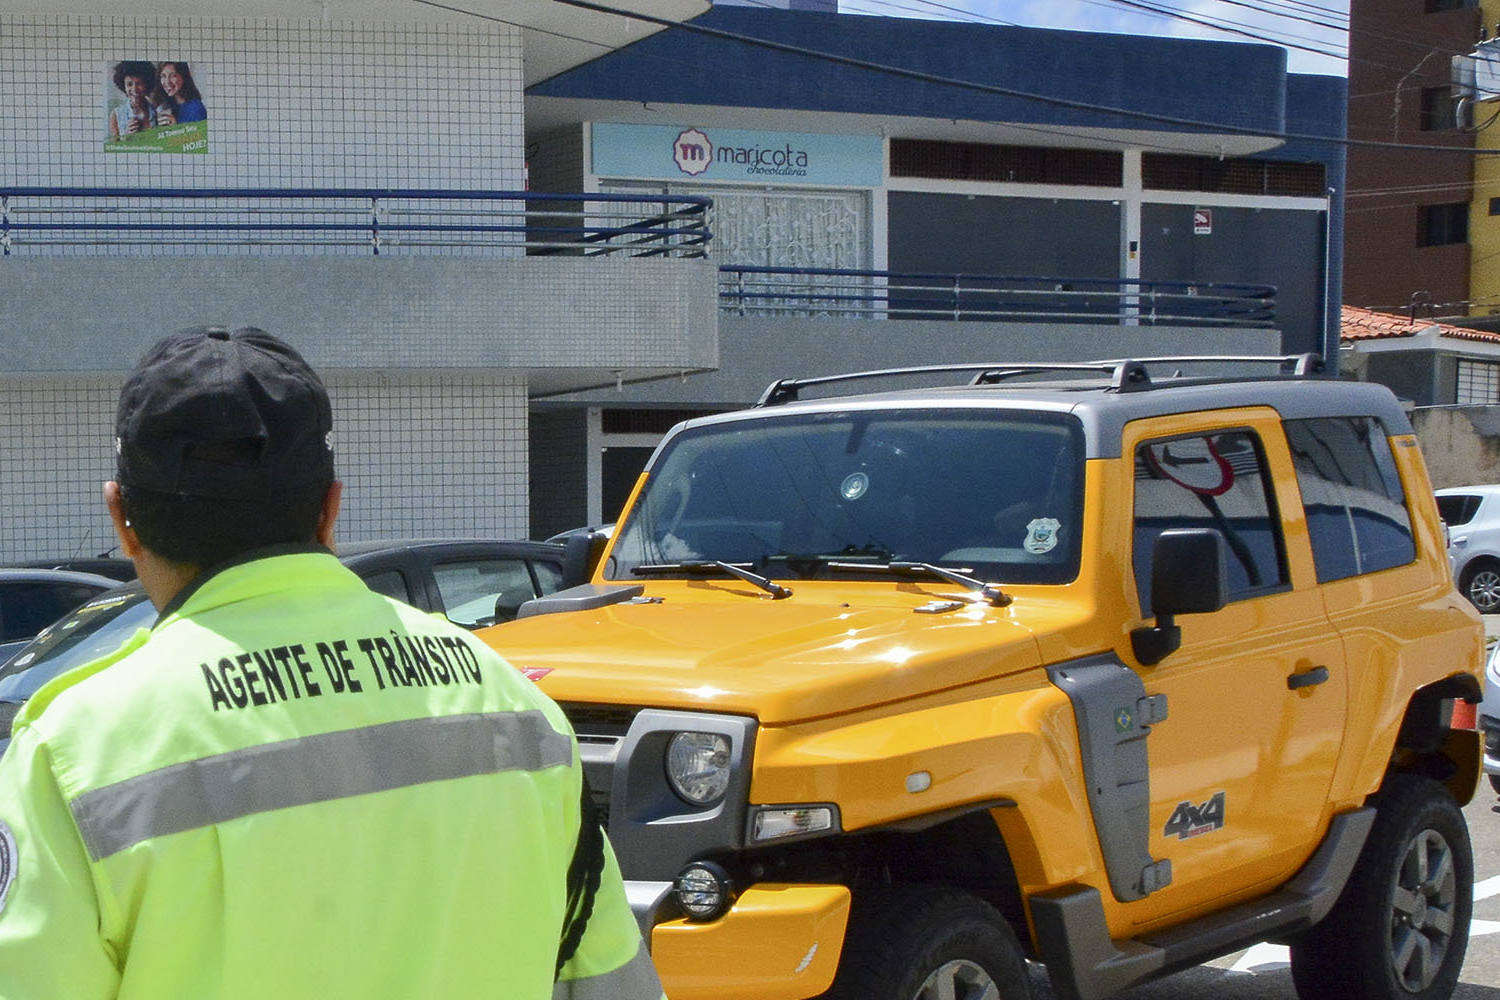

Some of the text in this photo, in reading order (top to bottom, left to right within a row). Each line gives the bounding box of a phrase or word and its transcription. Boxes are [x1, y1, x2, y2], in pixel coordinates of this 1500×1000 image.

[716, 143, 809, 168] maricota
[200, 629, 483, 712] AGENTE DE TRÂNSITO
[1163, 789, 1226, 842] 4x4
